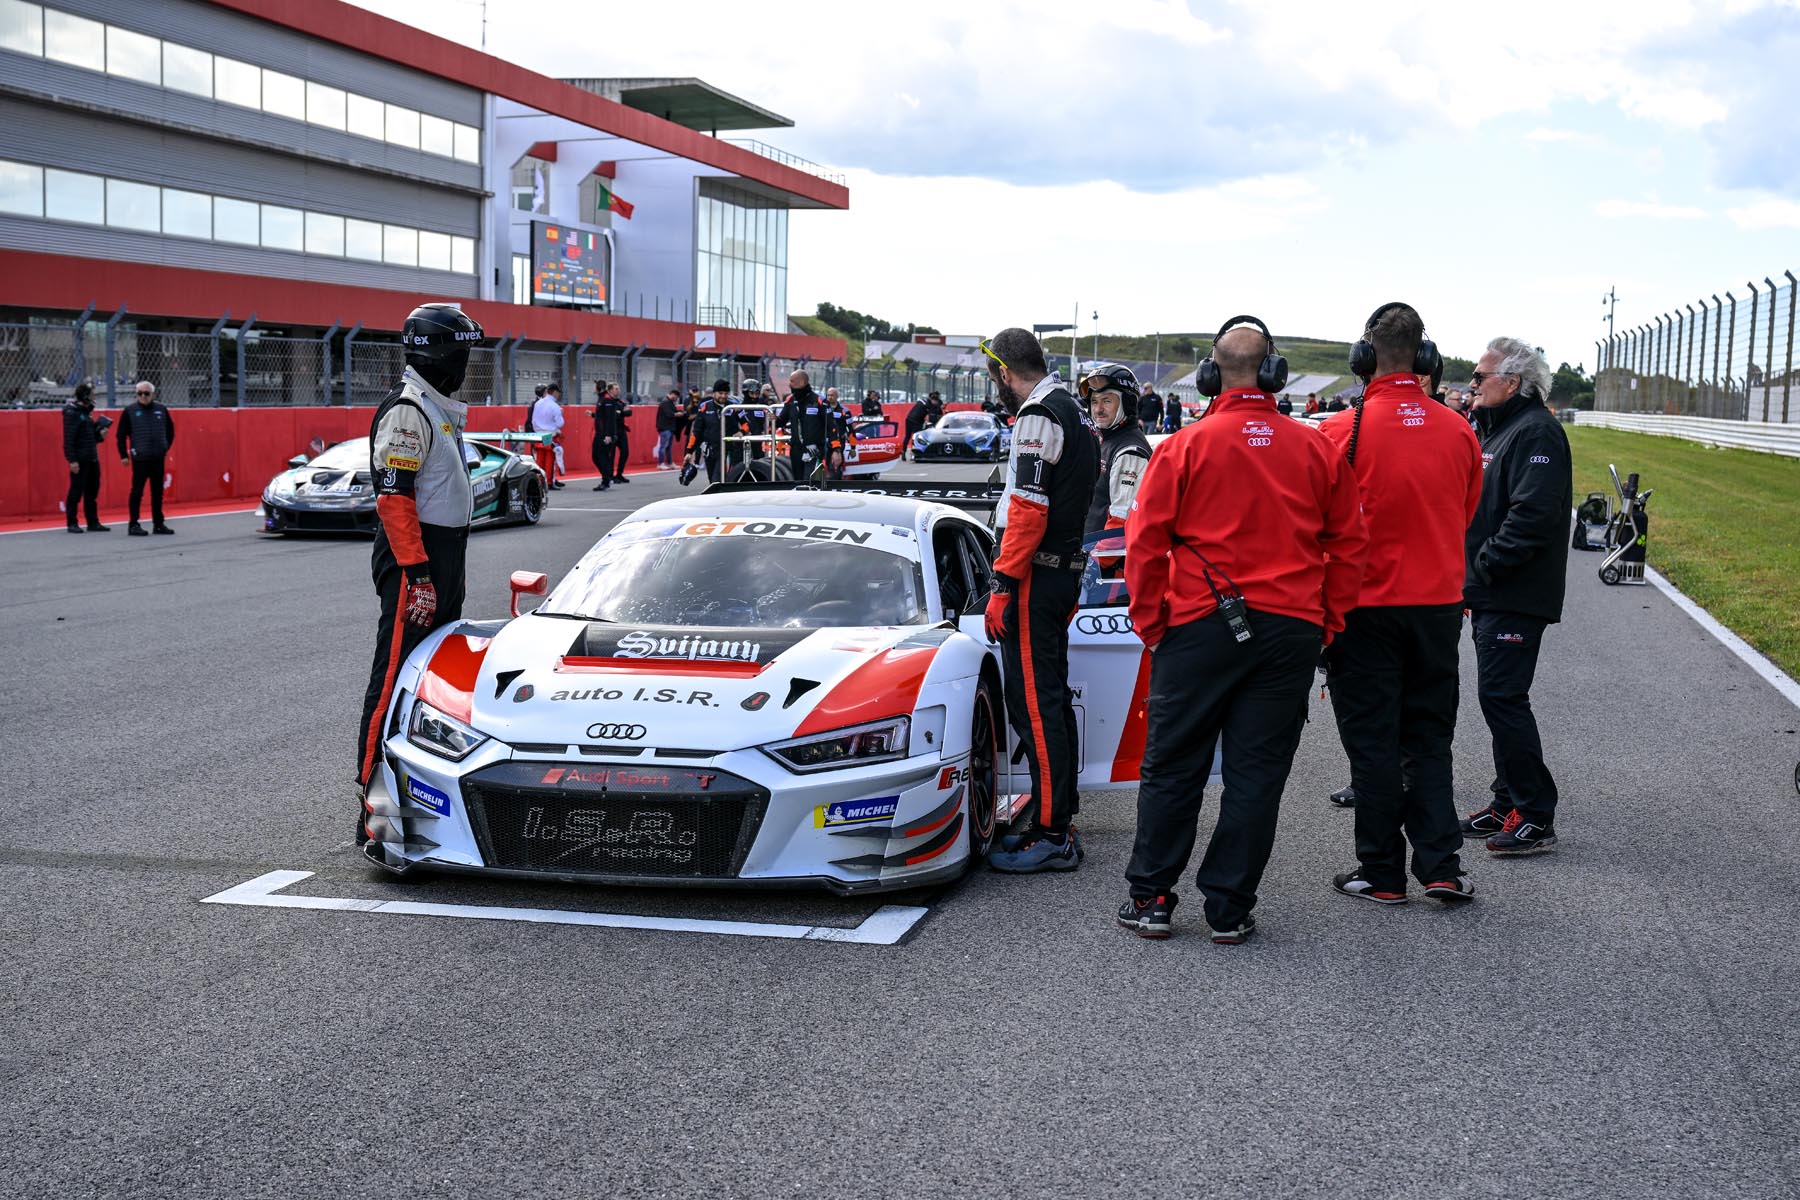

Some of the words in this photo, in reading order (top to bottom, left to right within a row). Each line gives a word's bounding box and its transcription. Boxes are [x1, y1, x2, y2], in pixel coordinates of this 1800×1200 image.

[454, 331, 482, 340] uvex
[383, 466, 397, 487] 3
[1033, 459, 1044, 485] 1
[613, 630, 761, 662] Svijany
[550, 687, 624, 701] auto
[632, 687, 720, 707] I.S.R.
[566, 768, 610, 784] Audi
[616, 770, 671, 787] Sport
[412, 786, 444, 807] MICHELIN
